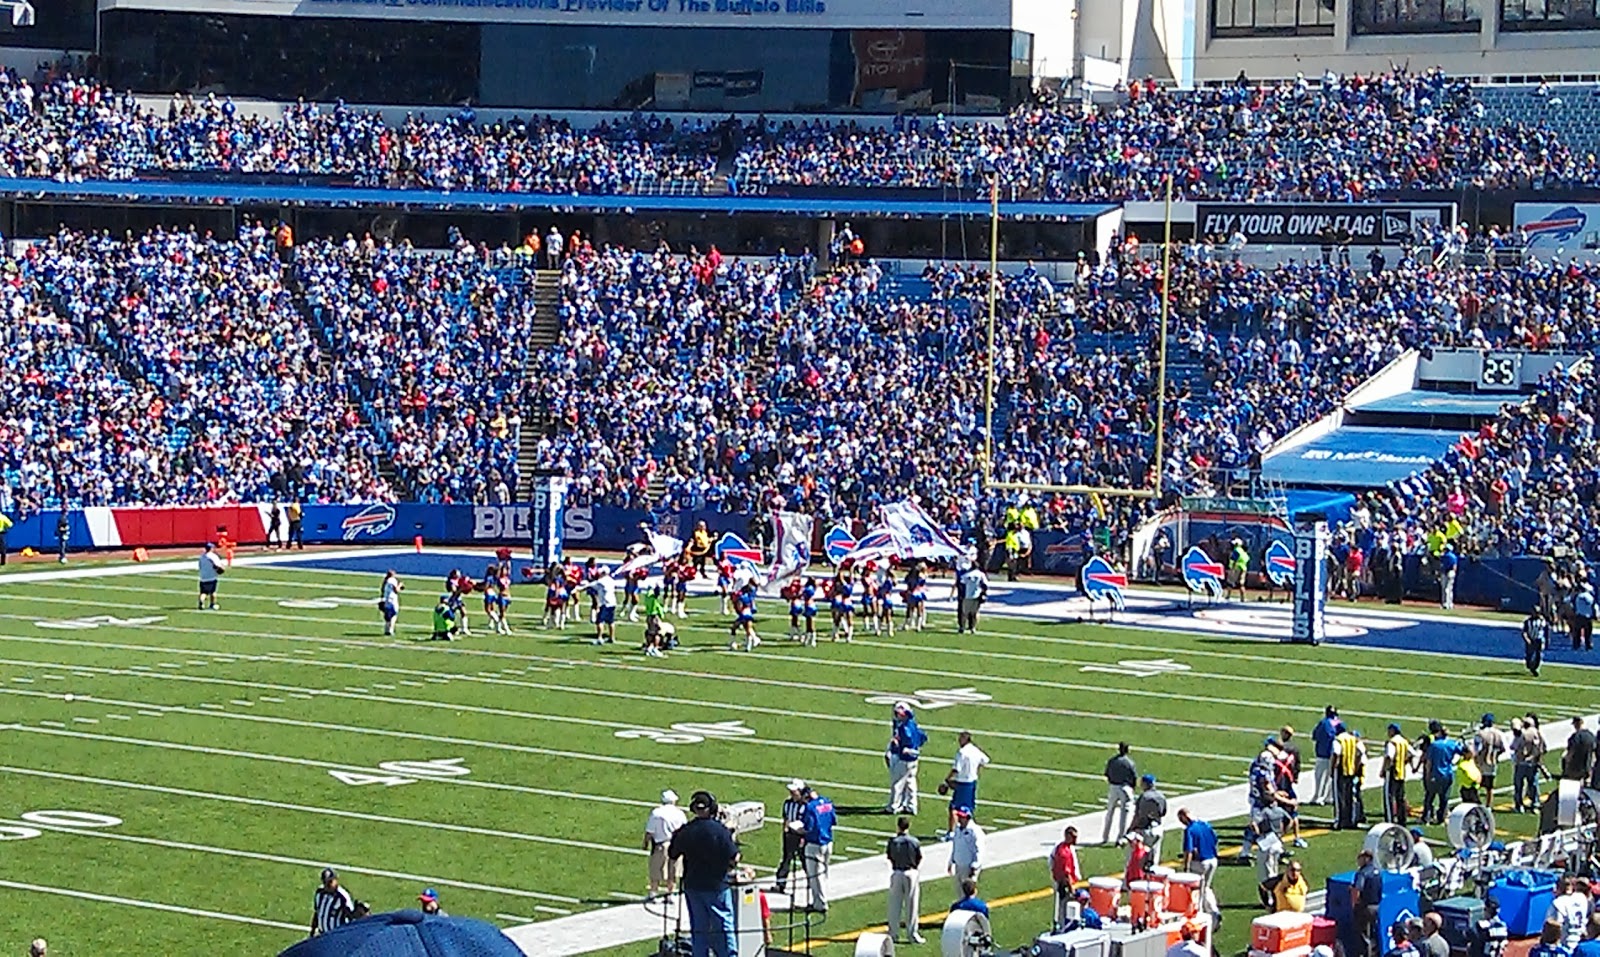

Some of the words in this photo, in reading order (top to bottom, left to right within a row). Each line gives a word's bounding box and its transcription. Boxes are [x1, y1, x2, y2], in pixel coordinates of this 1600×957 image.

[677, 0, 711, 12] The
[715, 0, 780, 13] Buffalo
[785, 0, 826, 13] Bills
[1203, 214, 1235, 234] FLY
[1239, 214, 1286, 235] YOUR
[1287, 214, 1332, 235] OWN
[1483, 359, 1514, 385] 25
[1294, 539, 1312, 640] BILLS
[1078, 658, 1192, 677] 10
[864, 687, 993, 709] 20
[614, 720, 756, 743] 30
[328, 758, 471, 786] 40
